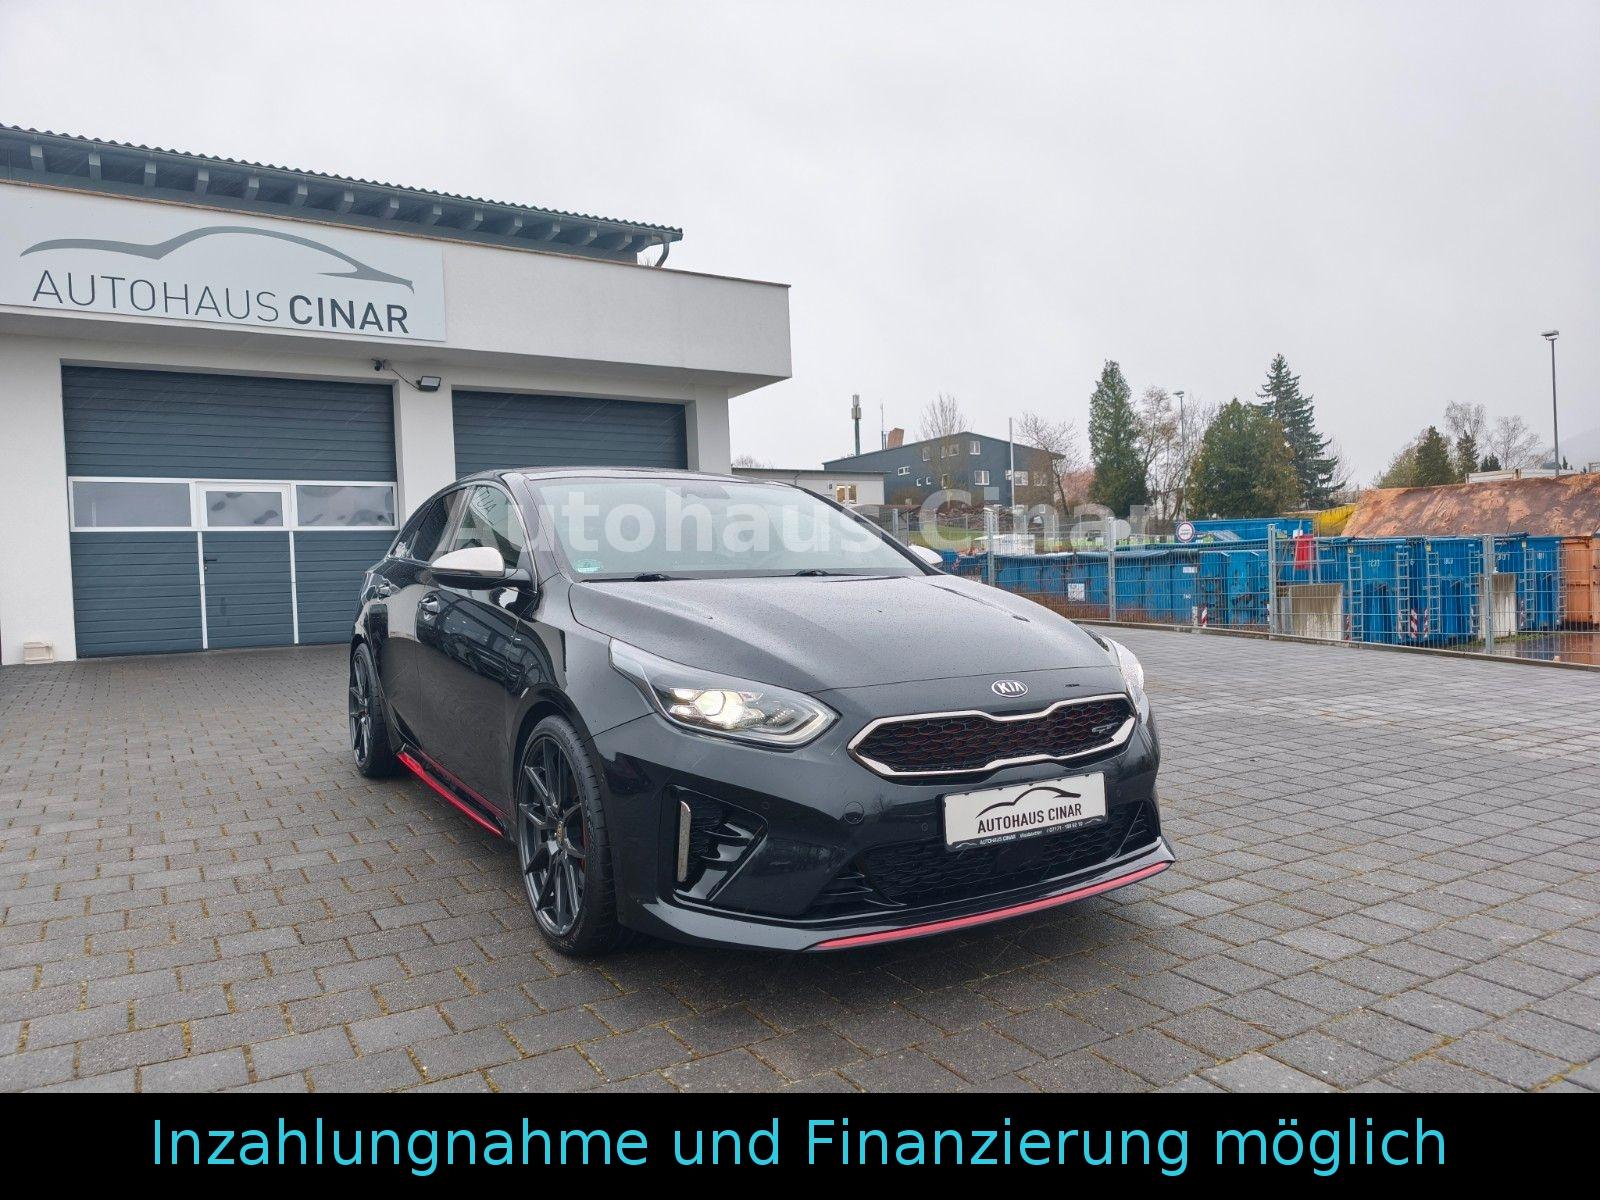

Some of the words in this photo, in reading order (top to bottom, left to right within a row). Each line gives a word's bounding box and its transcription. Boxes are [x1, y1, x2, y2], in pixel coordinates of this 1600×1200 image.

[33, 269, 279, 323] AUTOHAUS
[289, 294, 409, 334] CINAR
[996, 681, 1025, 694] KIA
[977, 809, 1045, 834] AUTOHAUS
[1048, 803, 1083, 821] CINAR
